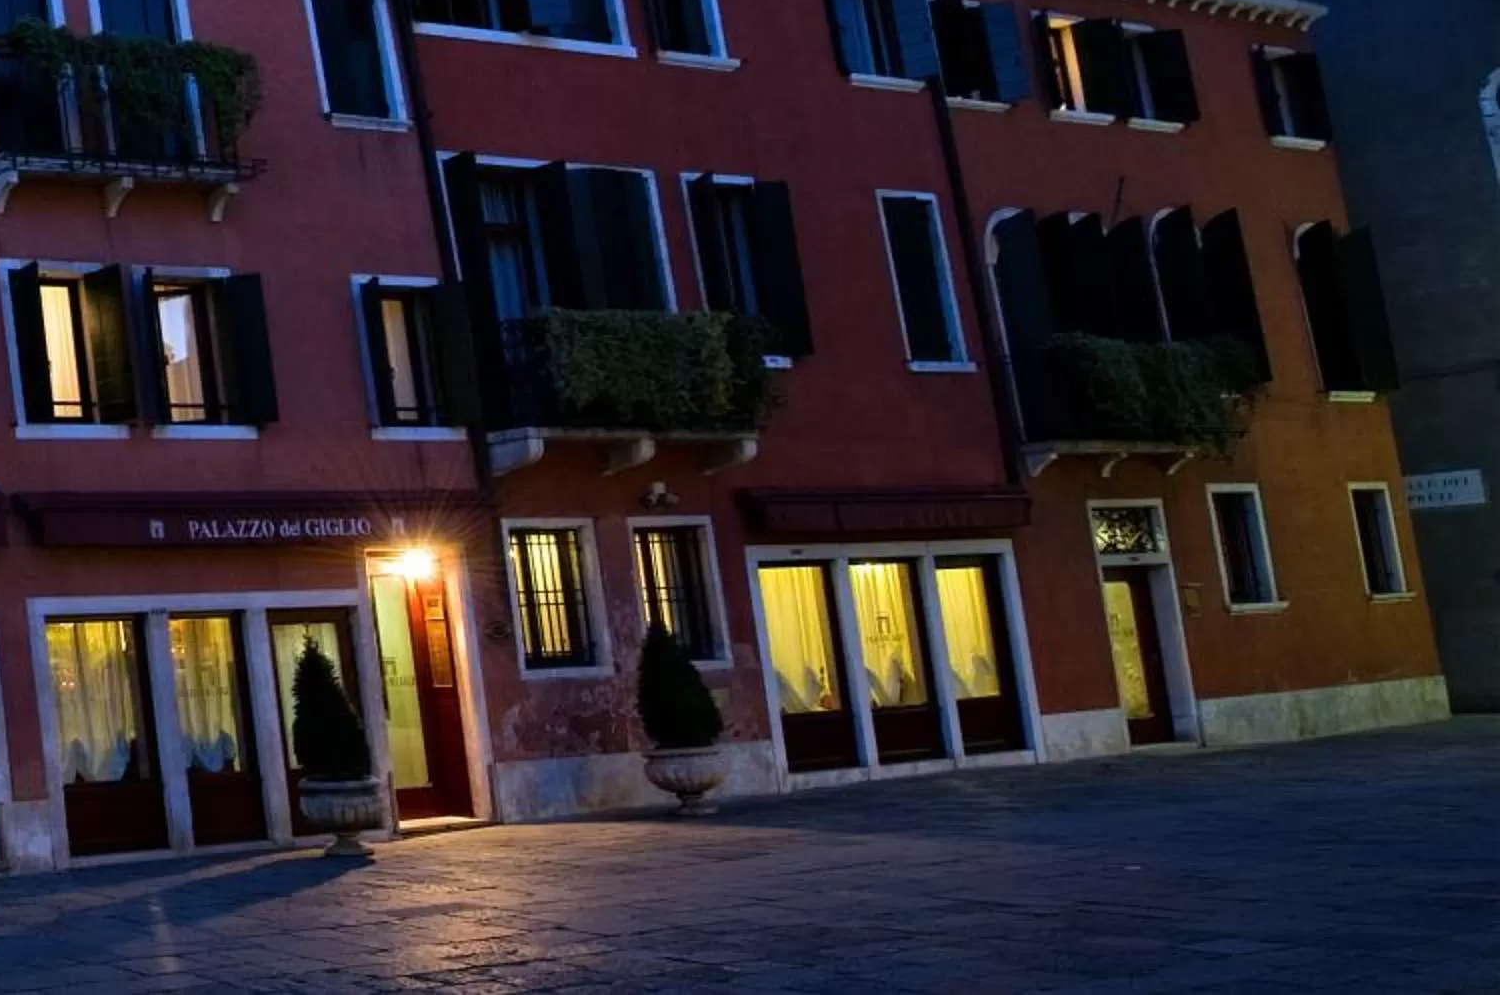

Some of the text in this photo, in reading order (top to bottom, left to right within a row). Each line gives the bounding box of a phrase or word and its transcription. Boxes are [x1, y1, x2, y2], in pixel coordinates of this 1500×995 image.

[188, 517, 372, 539] PALAZZO del GIGLIO
